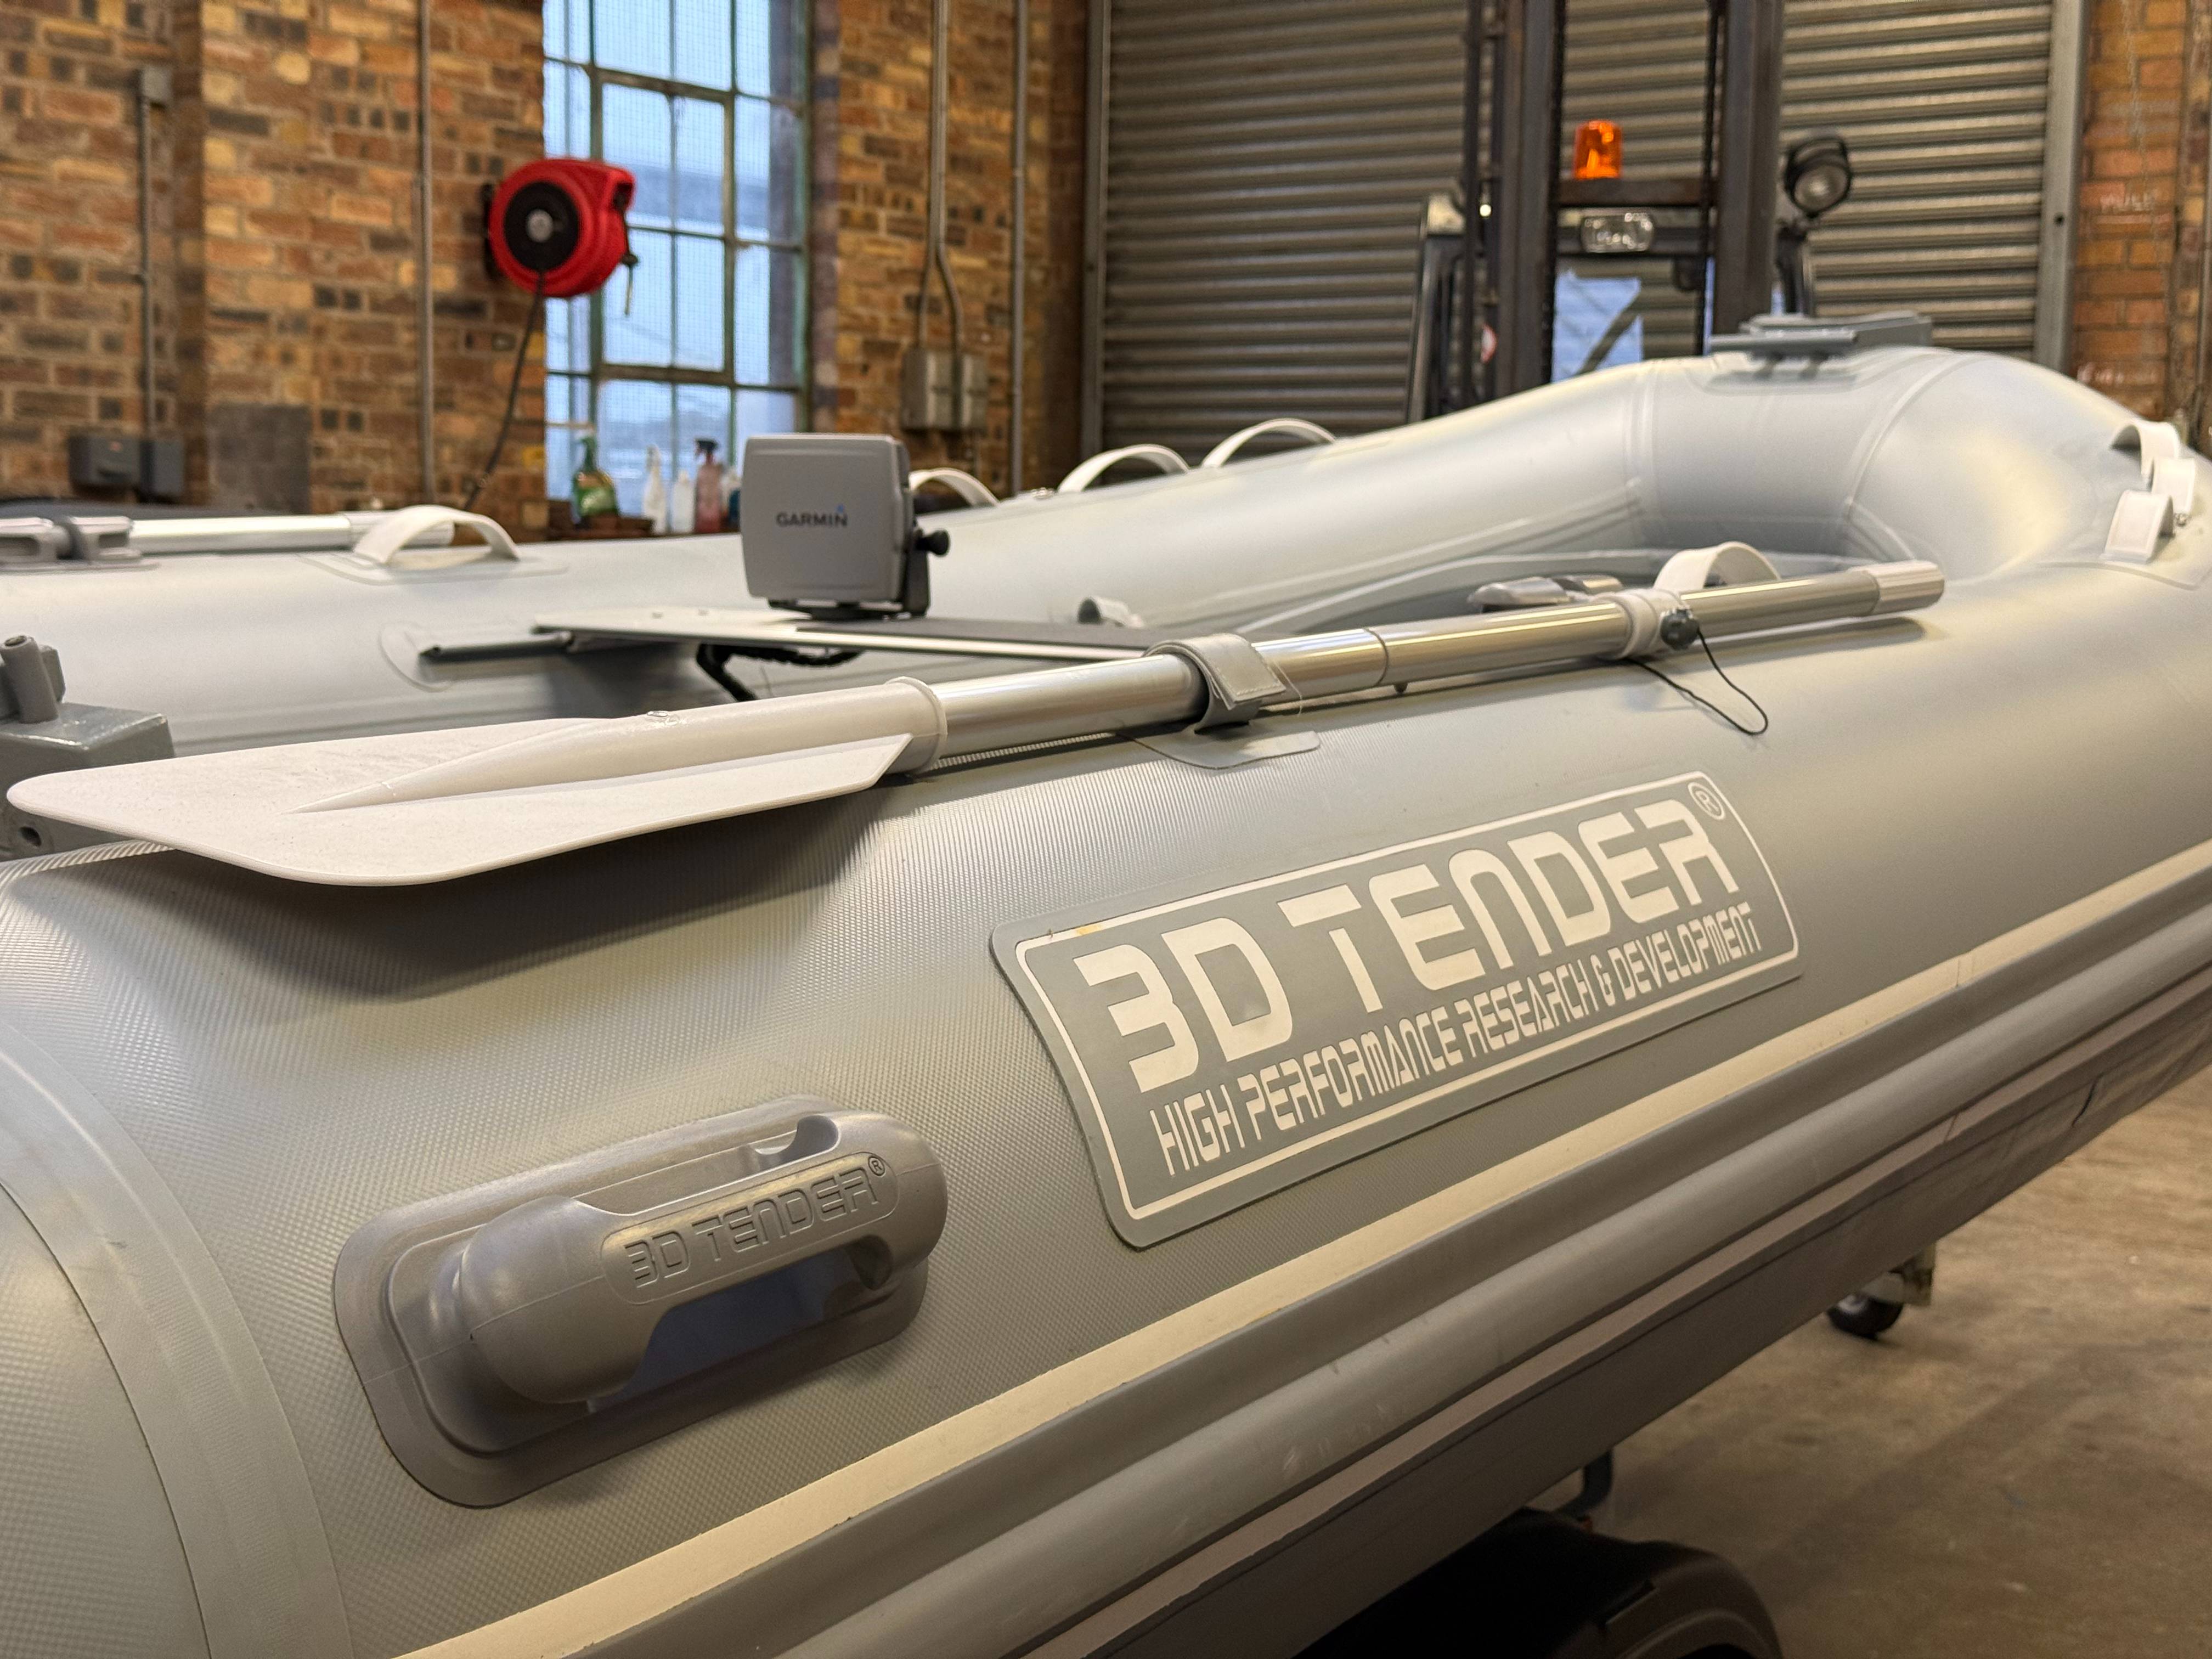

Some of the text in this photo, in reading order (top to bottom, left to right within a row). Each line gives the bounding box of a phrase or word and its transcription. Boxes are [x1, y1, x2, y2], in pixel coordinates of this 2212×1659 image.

[776, 512, 848, 527] GARMIN
[1073, 917, 1293, 1093] 3D
[1149, 901, 1762, 1176] HIGH PERFORMANCE RESEARCH & DEVELOPMENT
[624, 1230, 691, 1289] 3D
